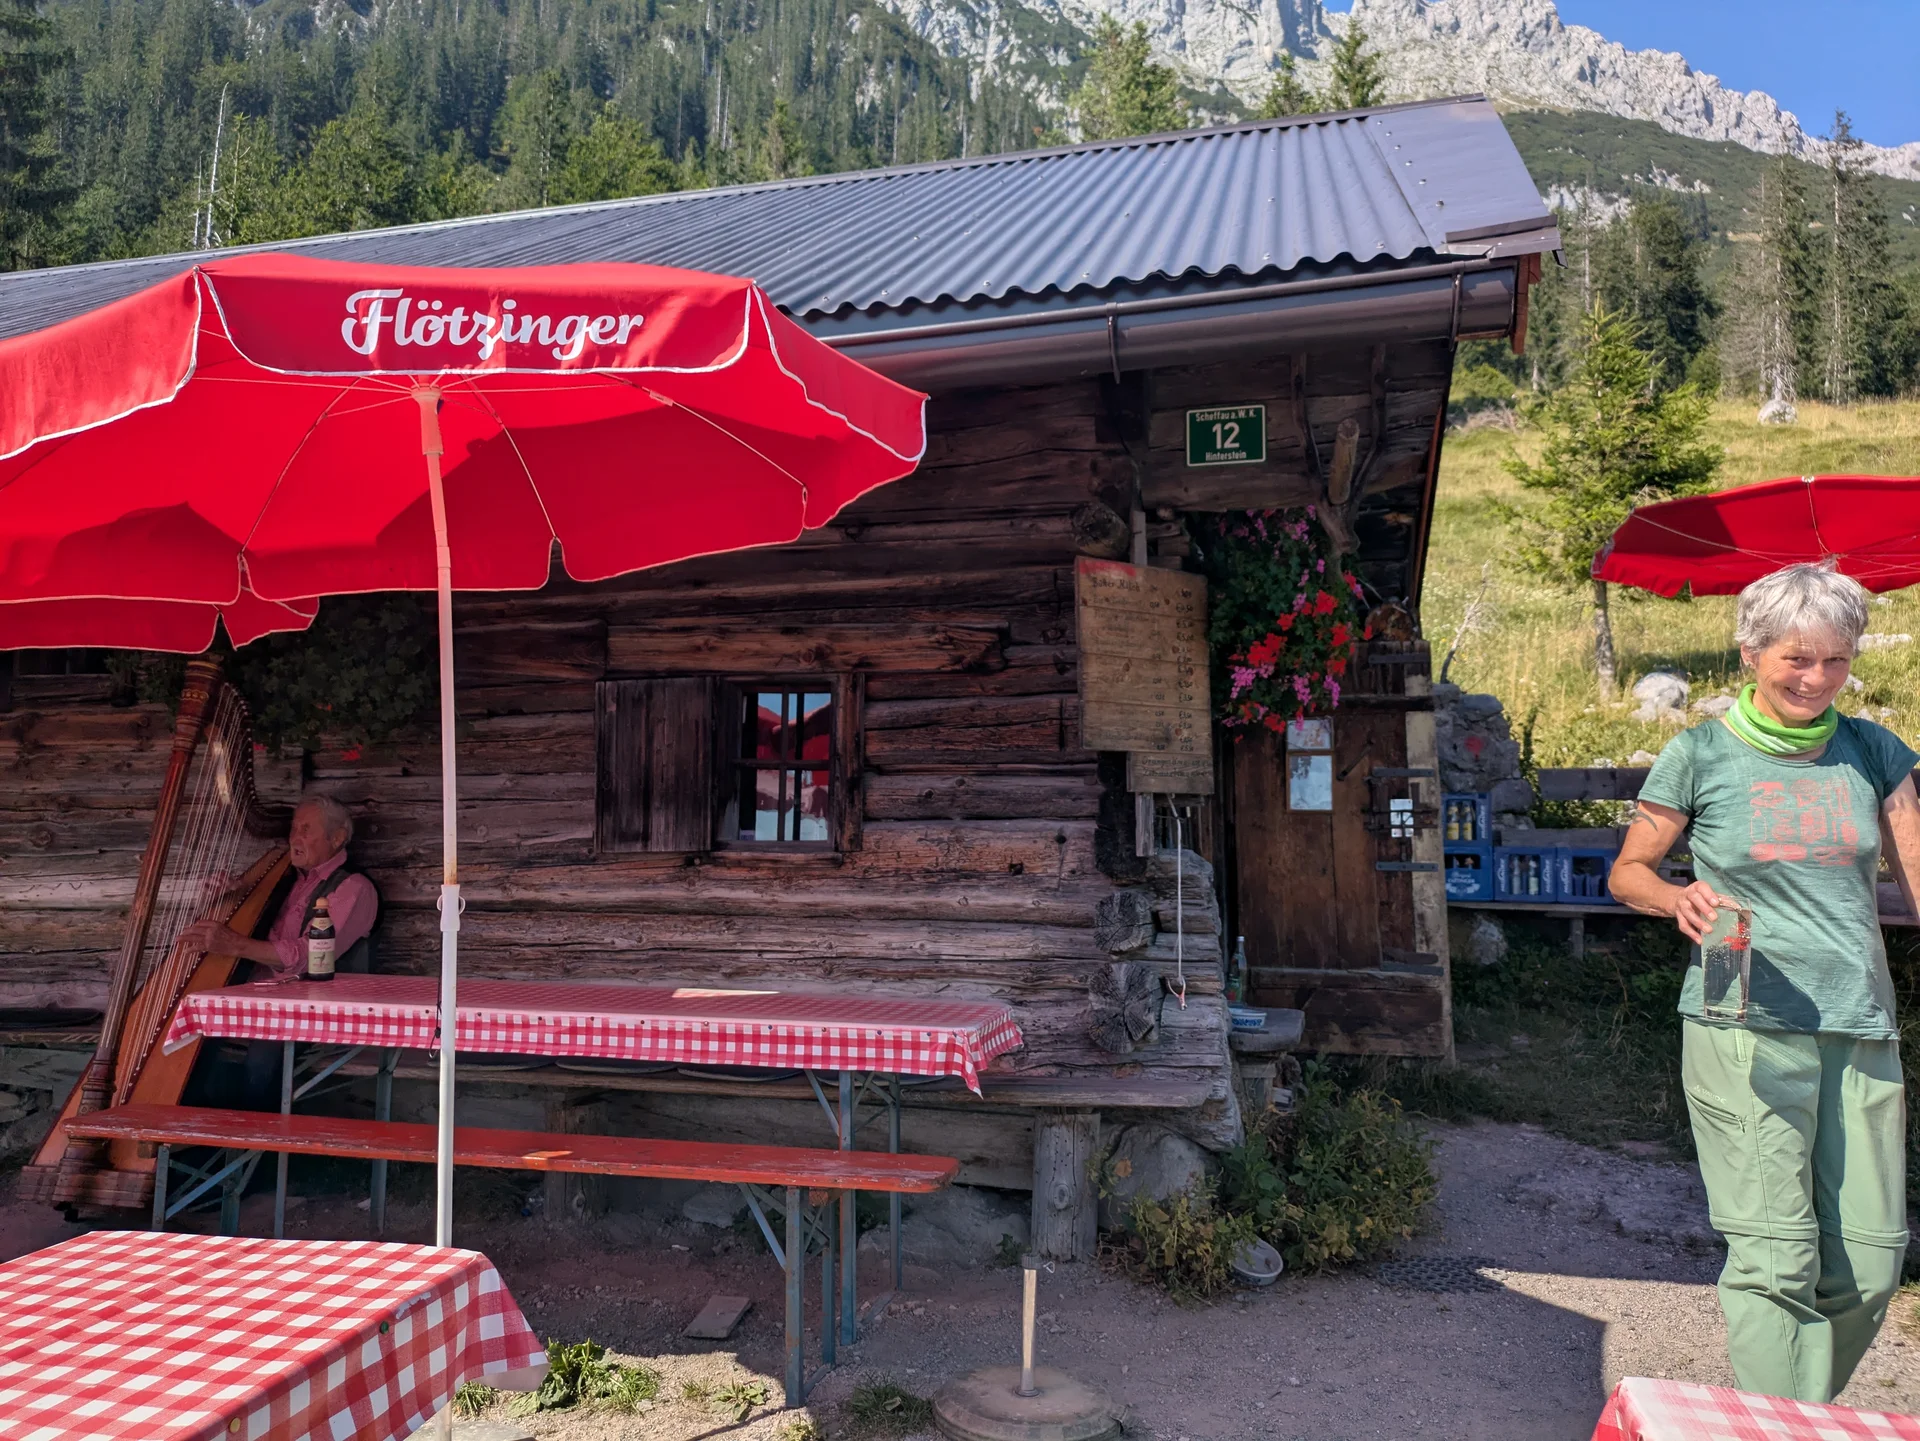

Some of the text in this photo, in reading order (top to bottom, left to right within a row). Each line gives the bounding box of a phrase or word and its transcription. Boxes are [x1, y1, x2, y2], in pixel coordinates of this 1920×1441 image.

[341, 288, 644, 361] Flötzinger
[1195, 411, 1229, 421] Scheffau
[1212, 421, 1240, 449] 12
[1205, 450, 1247, 461] Hinterstein
